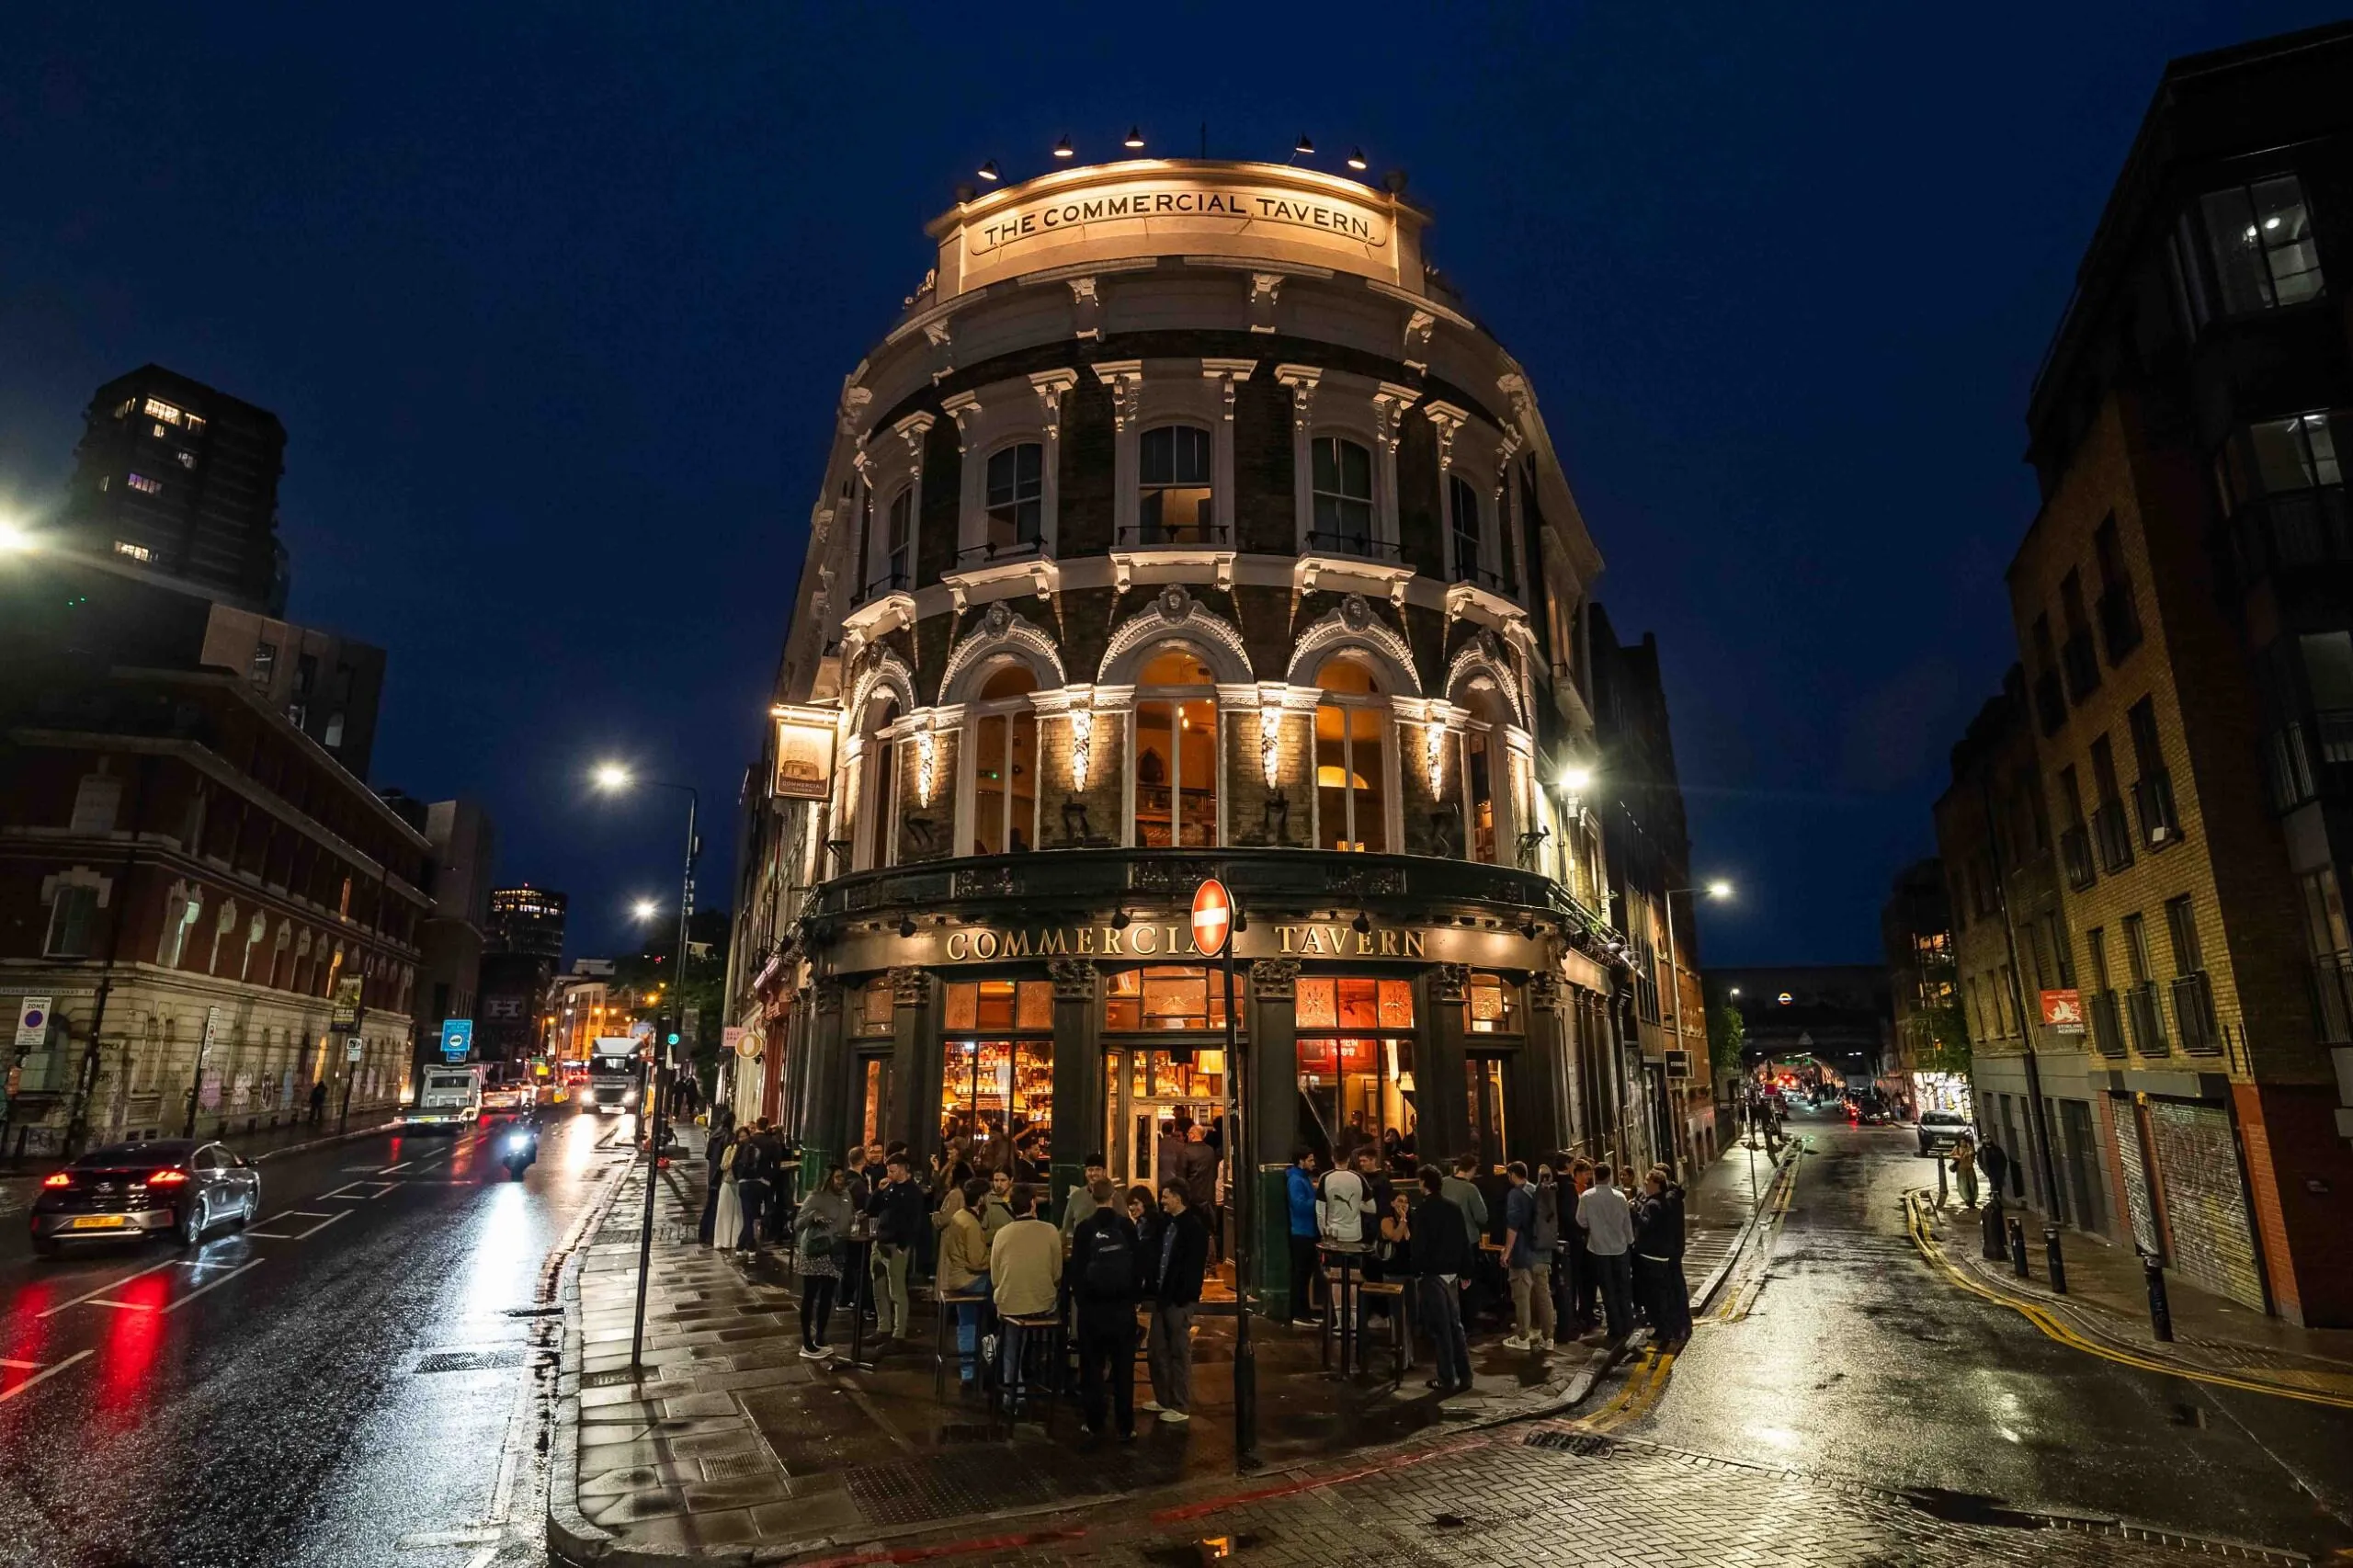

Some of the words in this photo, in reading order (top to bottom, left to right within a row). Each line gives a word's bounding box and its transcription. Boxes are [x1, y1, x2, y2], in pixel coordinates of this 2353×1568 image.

[984, 214, 1036, 245] THE
[1043, 193, 1247, 227] COMMERCIAL
[1256, 198, 1369, 238] TAVERN
[782, 780, 824, 790] COMMERCIAL
[1274, 926, 1427, 958] TAVERN
